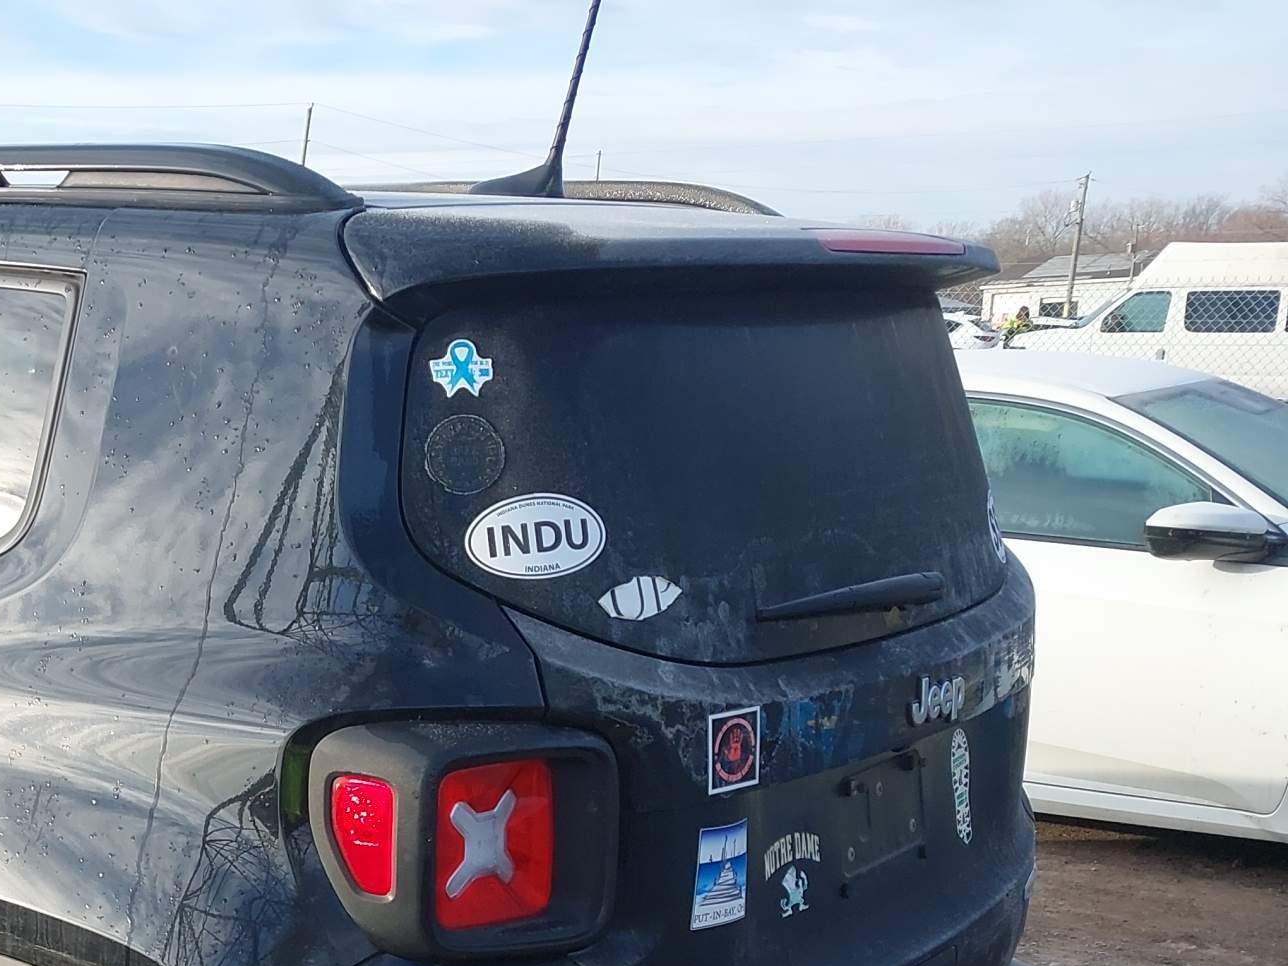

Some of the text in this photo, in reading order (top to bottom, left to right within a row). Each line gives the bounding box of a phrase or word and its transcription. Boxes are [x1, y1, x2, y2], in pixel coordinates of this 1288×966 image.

[496, 505, 518, 518] INDIANA
[486, 518, 591, 559] INDU
[524, 562, 561, 574] INDIANA
[912, 676, 966, 725] Jeep
[763, 831, 821, 881] NOTRE DAME
